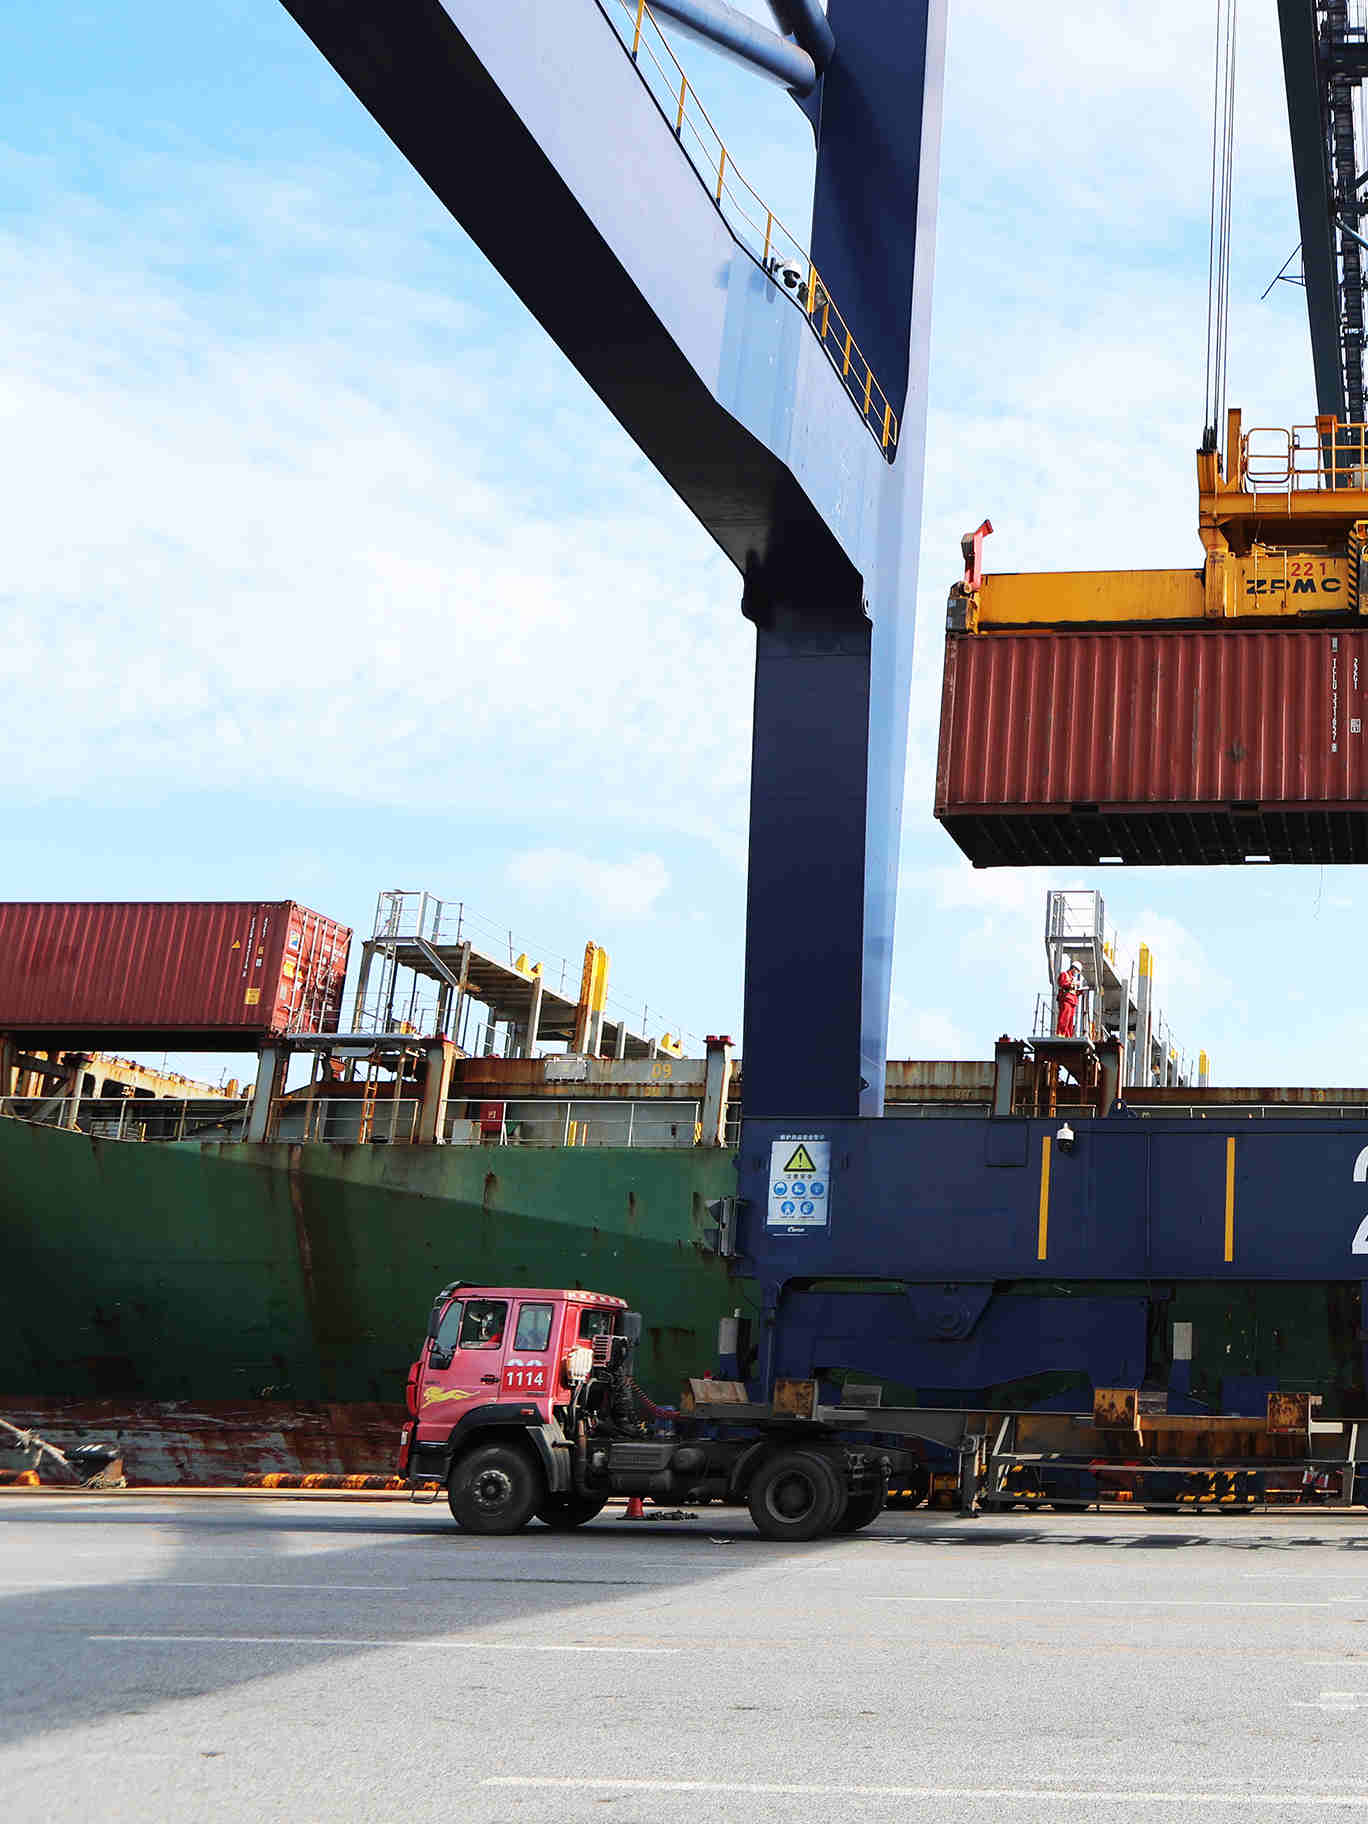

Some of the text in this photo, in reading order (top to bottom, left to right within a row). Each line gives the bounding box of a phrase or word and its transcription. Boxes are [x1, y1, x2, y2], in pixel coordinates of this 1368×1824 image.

[1291, 562, 1327, 577] 221
[1246, 577, 1341, 595] ZPMC
[507, 1372, 544, 1386] 1114
